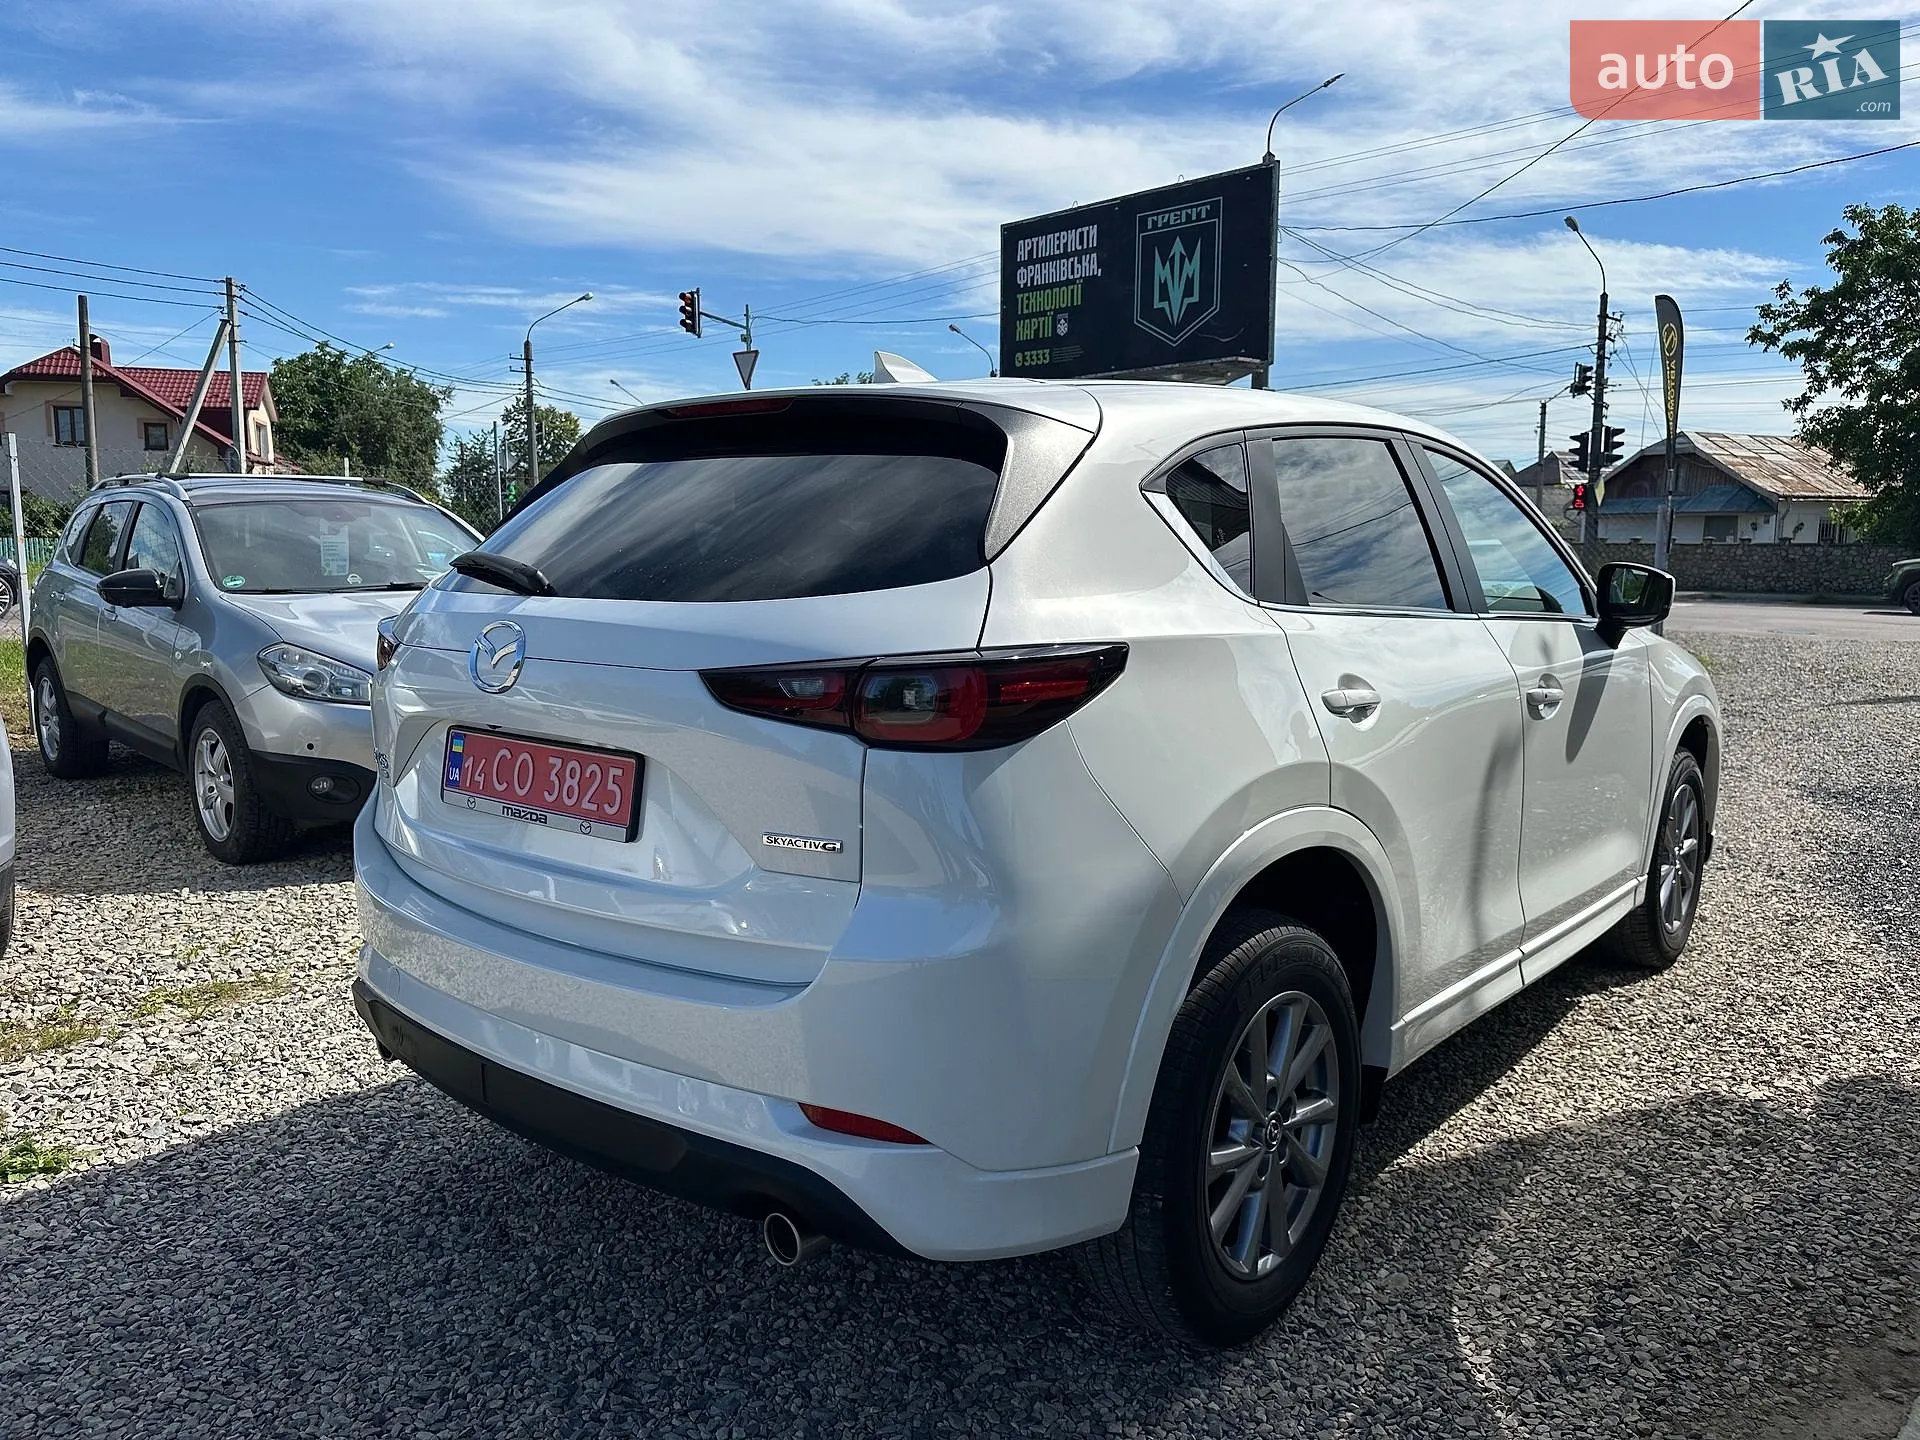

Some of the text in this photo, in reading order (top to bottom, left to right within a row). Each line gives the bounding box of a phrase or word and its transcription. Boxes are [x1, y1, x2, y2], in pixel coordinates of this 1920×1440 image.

[1016, 224, 1098, 262] АРТИЛЕРИСТИ
[1016, 252, 1102, 288] ФРАНКІВСЬКА,
[1016, 279, 1083, 315] ТЕХНОЛОГІЇ
[1015, 311, 1053, 342] ХАРТІЇ
[1023, 348, 1050, 366] 3333
[449, 766, 460, 782] UA
[464, 747, 624, 815] 14 CO 3825
